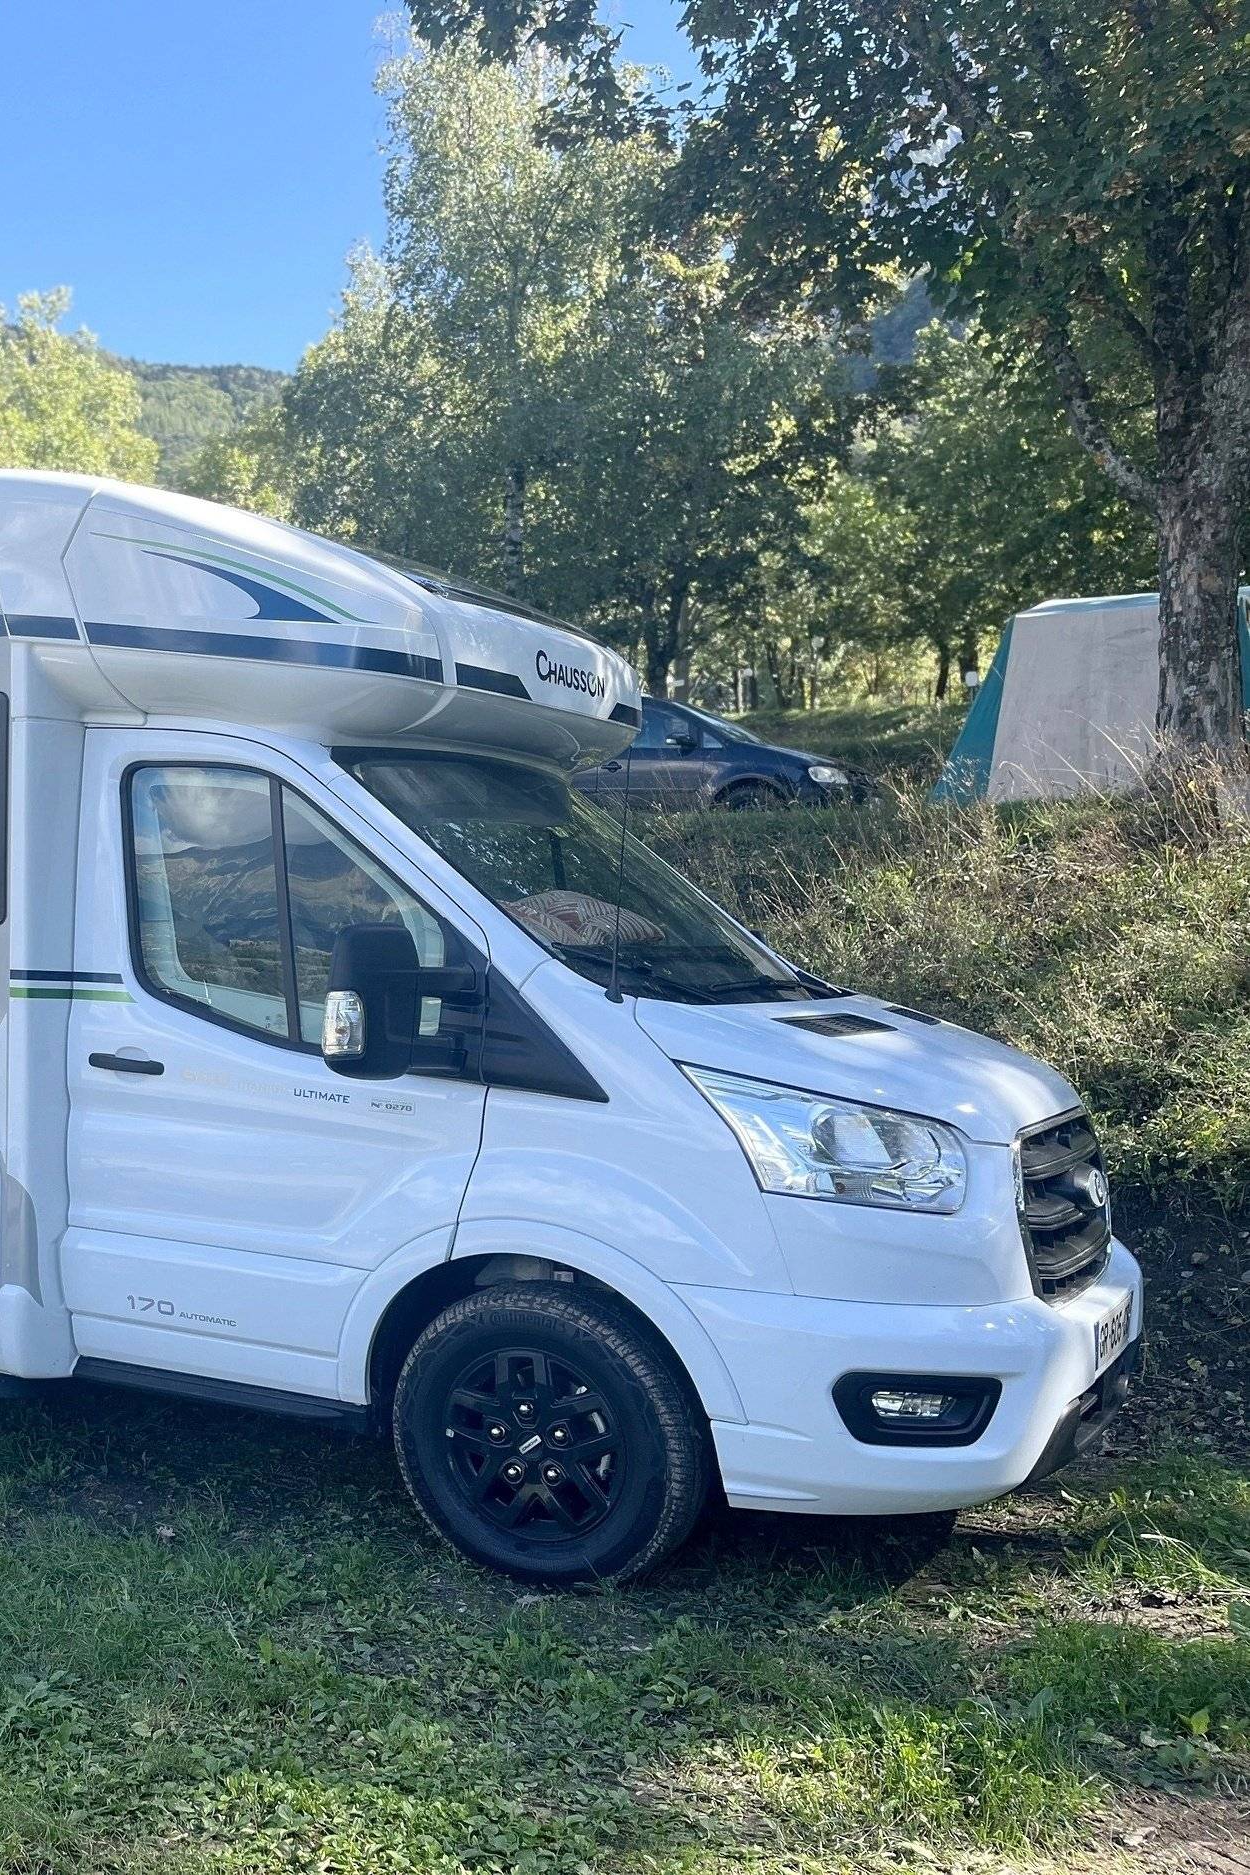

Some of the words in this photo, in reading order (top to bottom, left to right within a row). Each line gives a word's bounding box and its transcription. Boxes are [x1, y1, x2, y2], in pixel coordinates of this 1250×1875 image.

[535, 649, 605, 698] CHAUSSON
[293, 1087, 350, 1104] ULTIMATE
[127, 1294, 175, 1317] 170
[178, 1311, 237, 1327] AUTOMATIC
